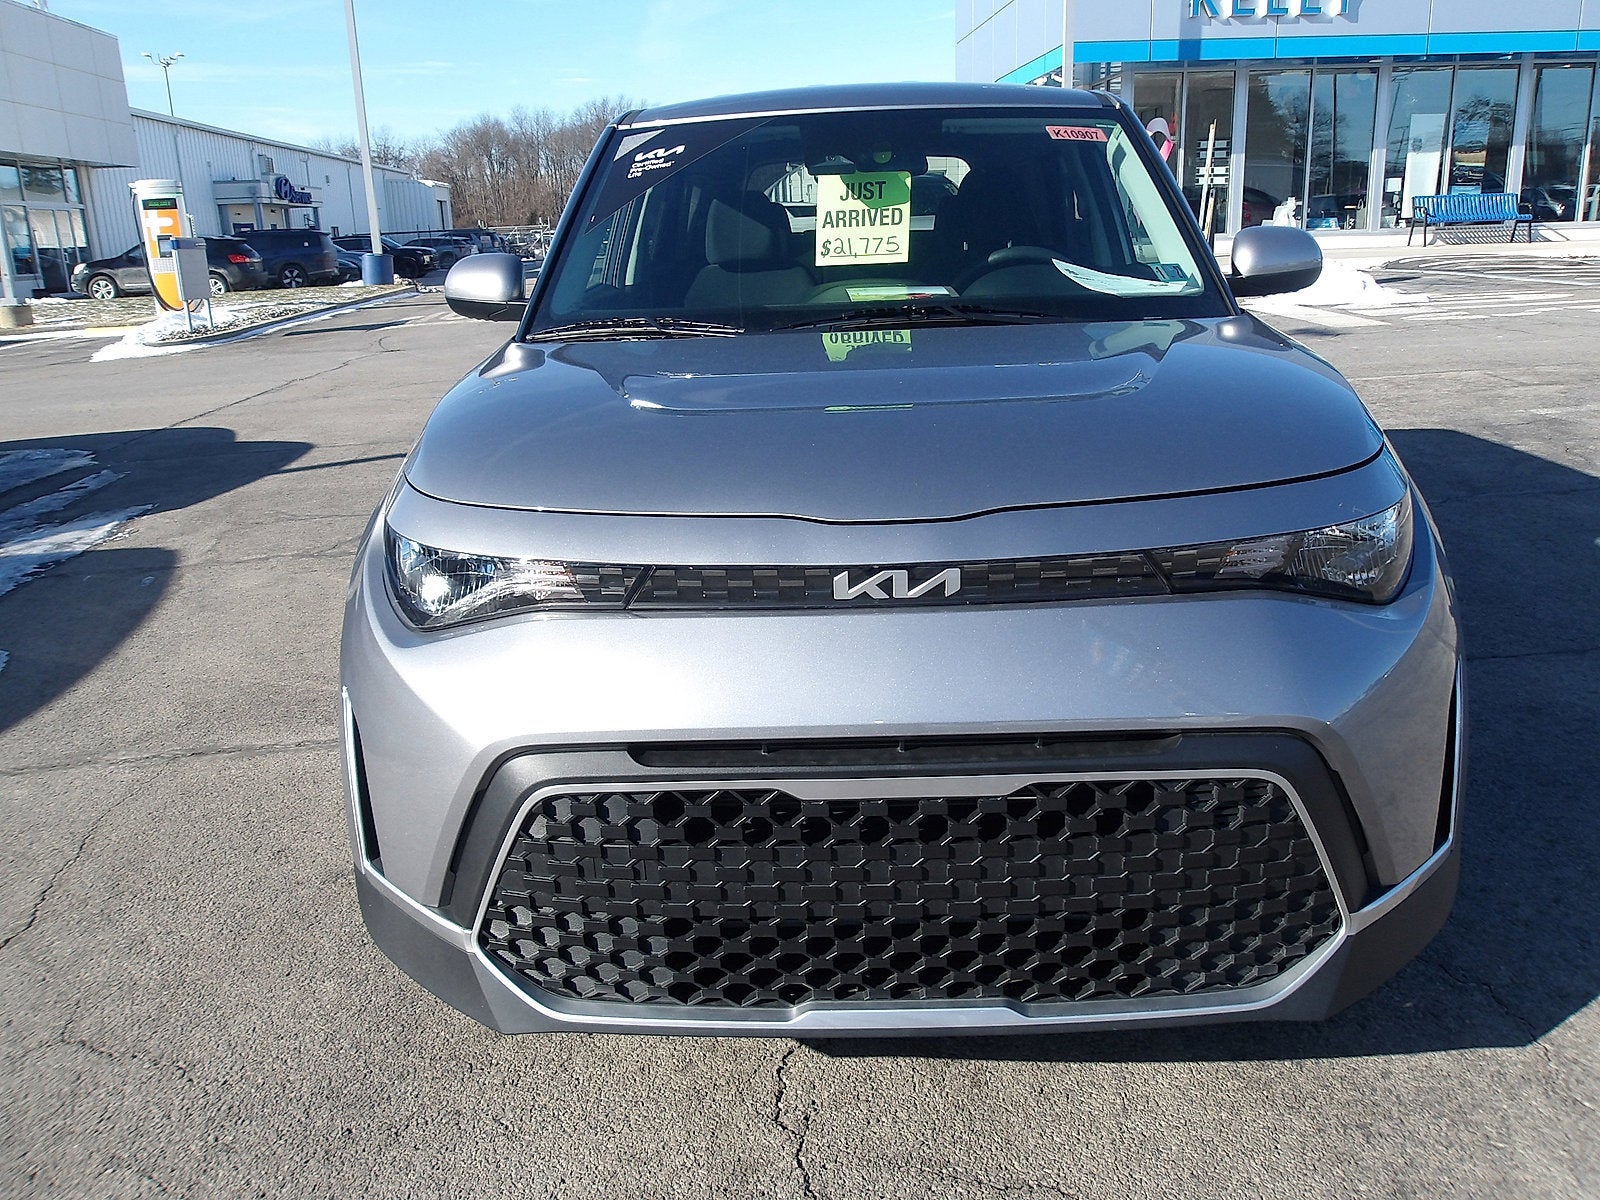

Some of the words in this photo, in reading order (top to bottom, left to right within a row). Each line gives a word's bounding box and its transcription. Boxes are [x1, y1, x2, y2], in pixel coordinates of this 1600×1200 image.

[1053, 129, 1099, 140] K10907
[840, 180, 887, 201] JUST
[822, 208, 903, 228] ARRIVED
[820, 236, 903, 258] $21,775
[833, 568, 960, 600] KIA
